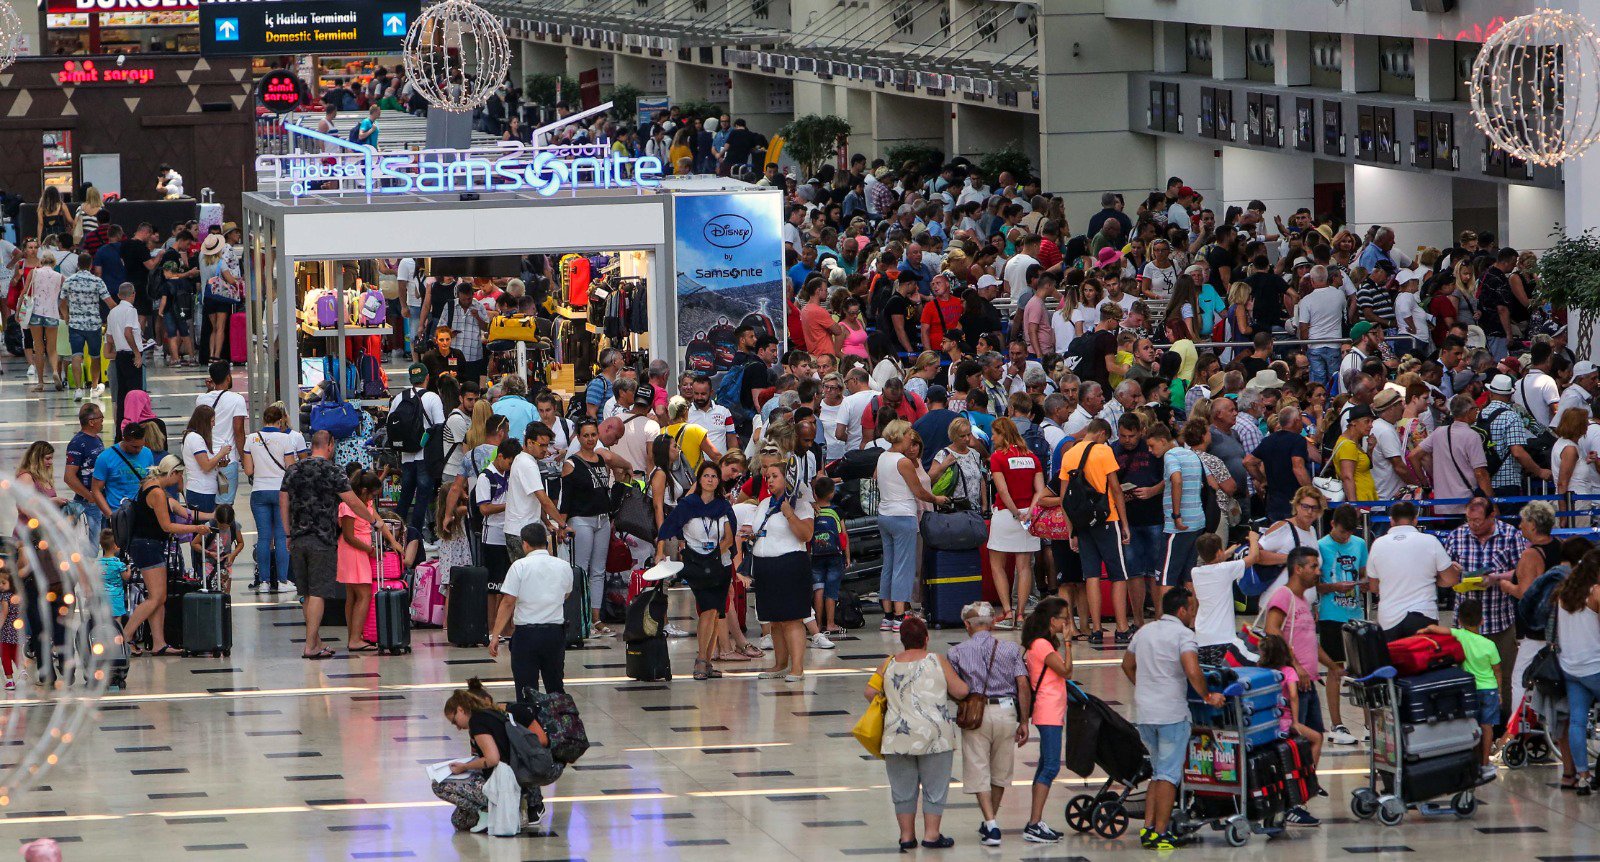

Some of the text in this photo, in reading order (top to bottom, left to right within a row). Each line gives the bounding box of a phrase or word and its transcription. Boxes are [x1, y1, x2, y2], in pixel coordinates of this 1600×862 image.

[265, 11, 357, 28] İç Hatlar Terminali
[265, 28, 357, 42] Domestic Terminal
[58, 60, 98, 82] simit
[268, 77, 294, 92] simit
[289, 159, 357, 178] House
[379, 151, 664, 196] Samsonite
[290, 179, 312, 196] of
[724, 253, 733, 262] by
[695, 267, 763, 279] Samsonite
[1215, 747, 1235, 764] fun!
